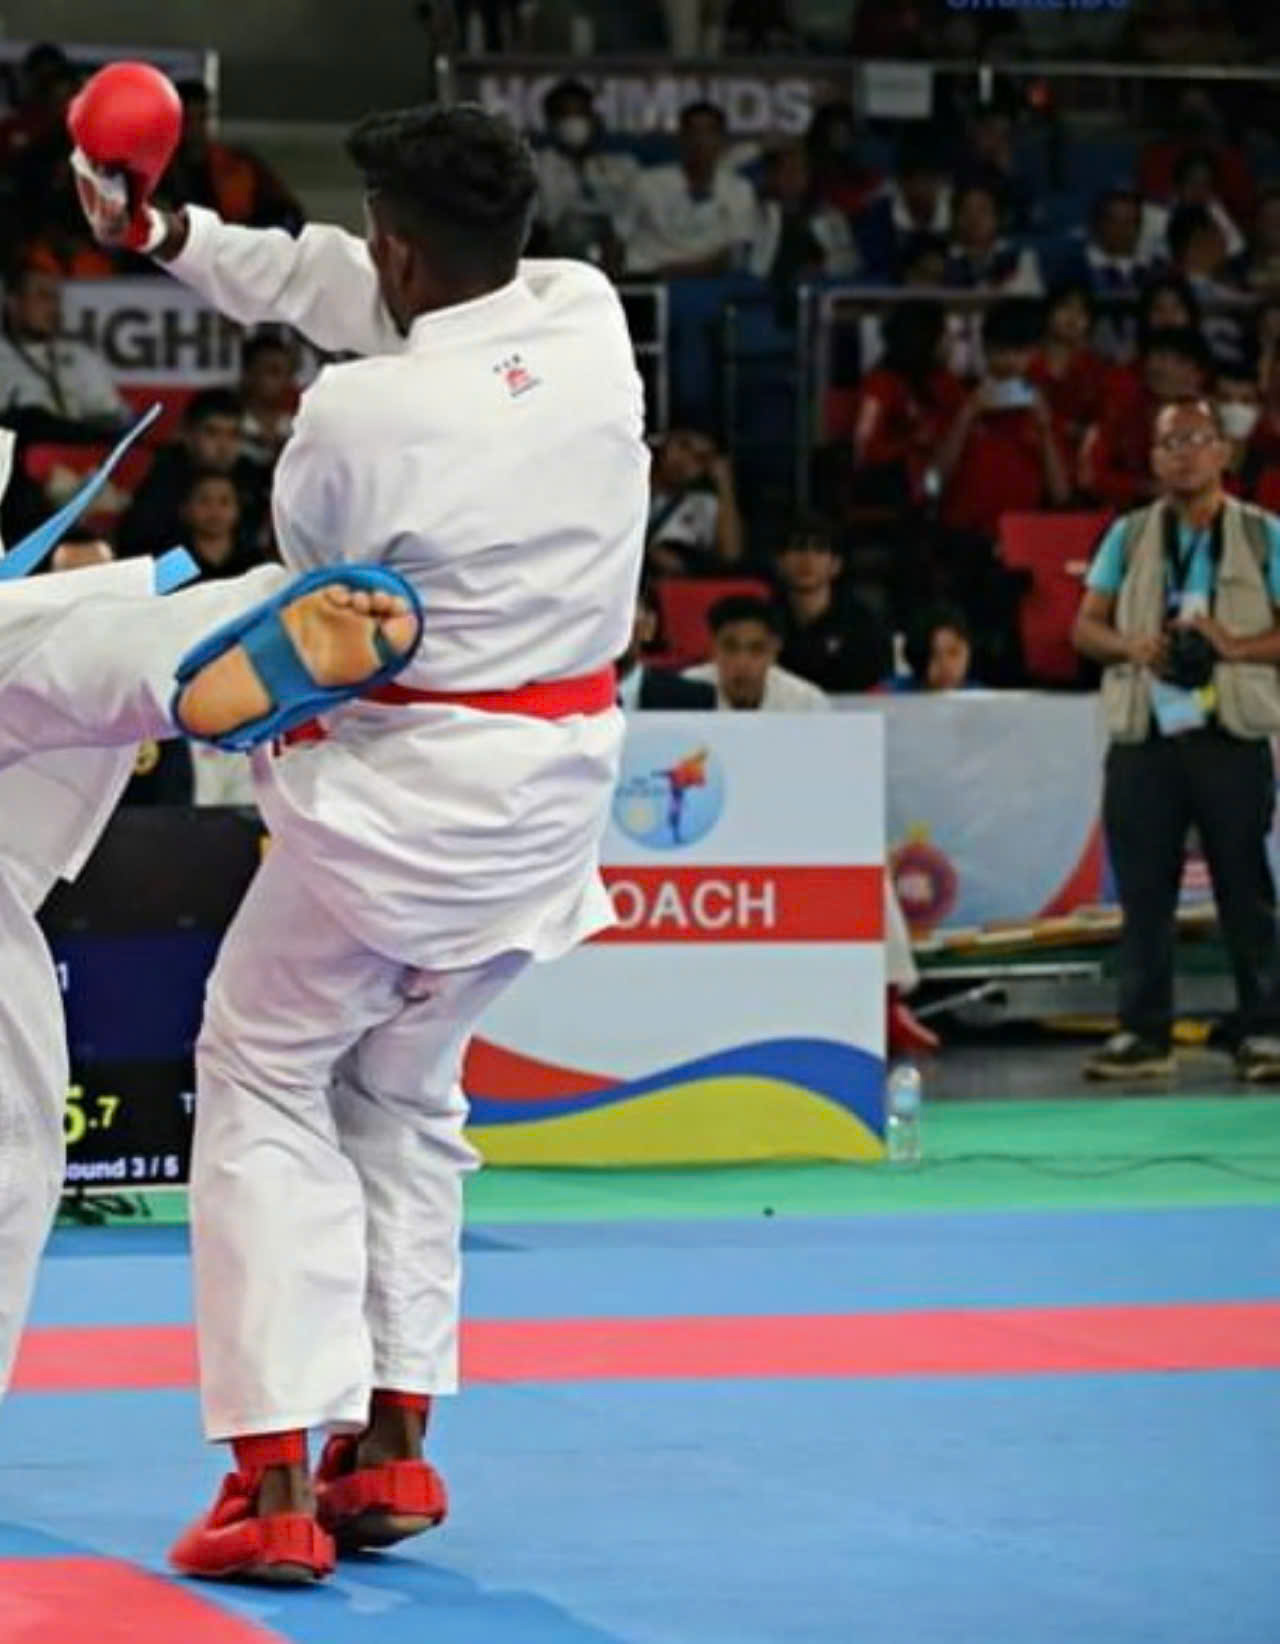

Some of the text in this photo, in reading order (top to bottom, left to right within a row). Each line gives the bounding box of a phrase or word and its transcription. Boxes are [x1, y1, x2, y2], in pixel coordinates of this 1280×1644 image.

[608, 880, 776, 929] OACH
[66, 1157, 126, 1180] ound
[131, 1156, 146, 1178] 3
